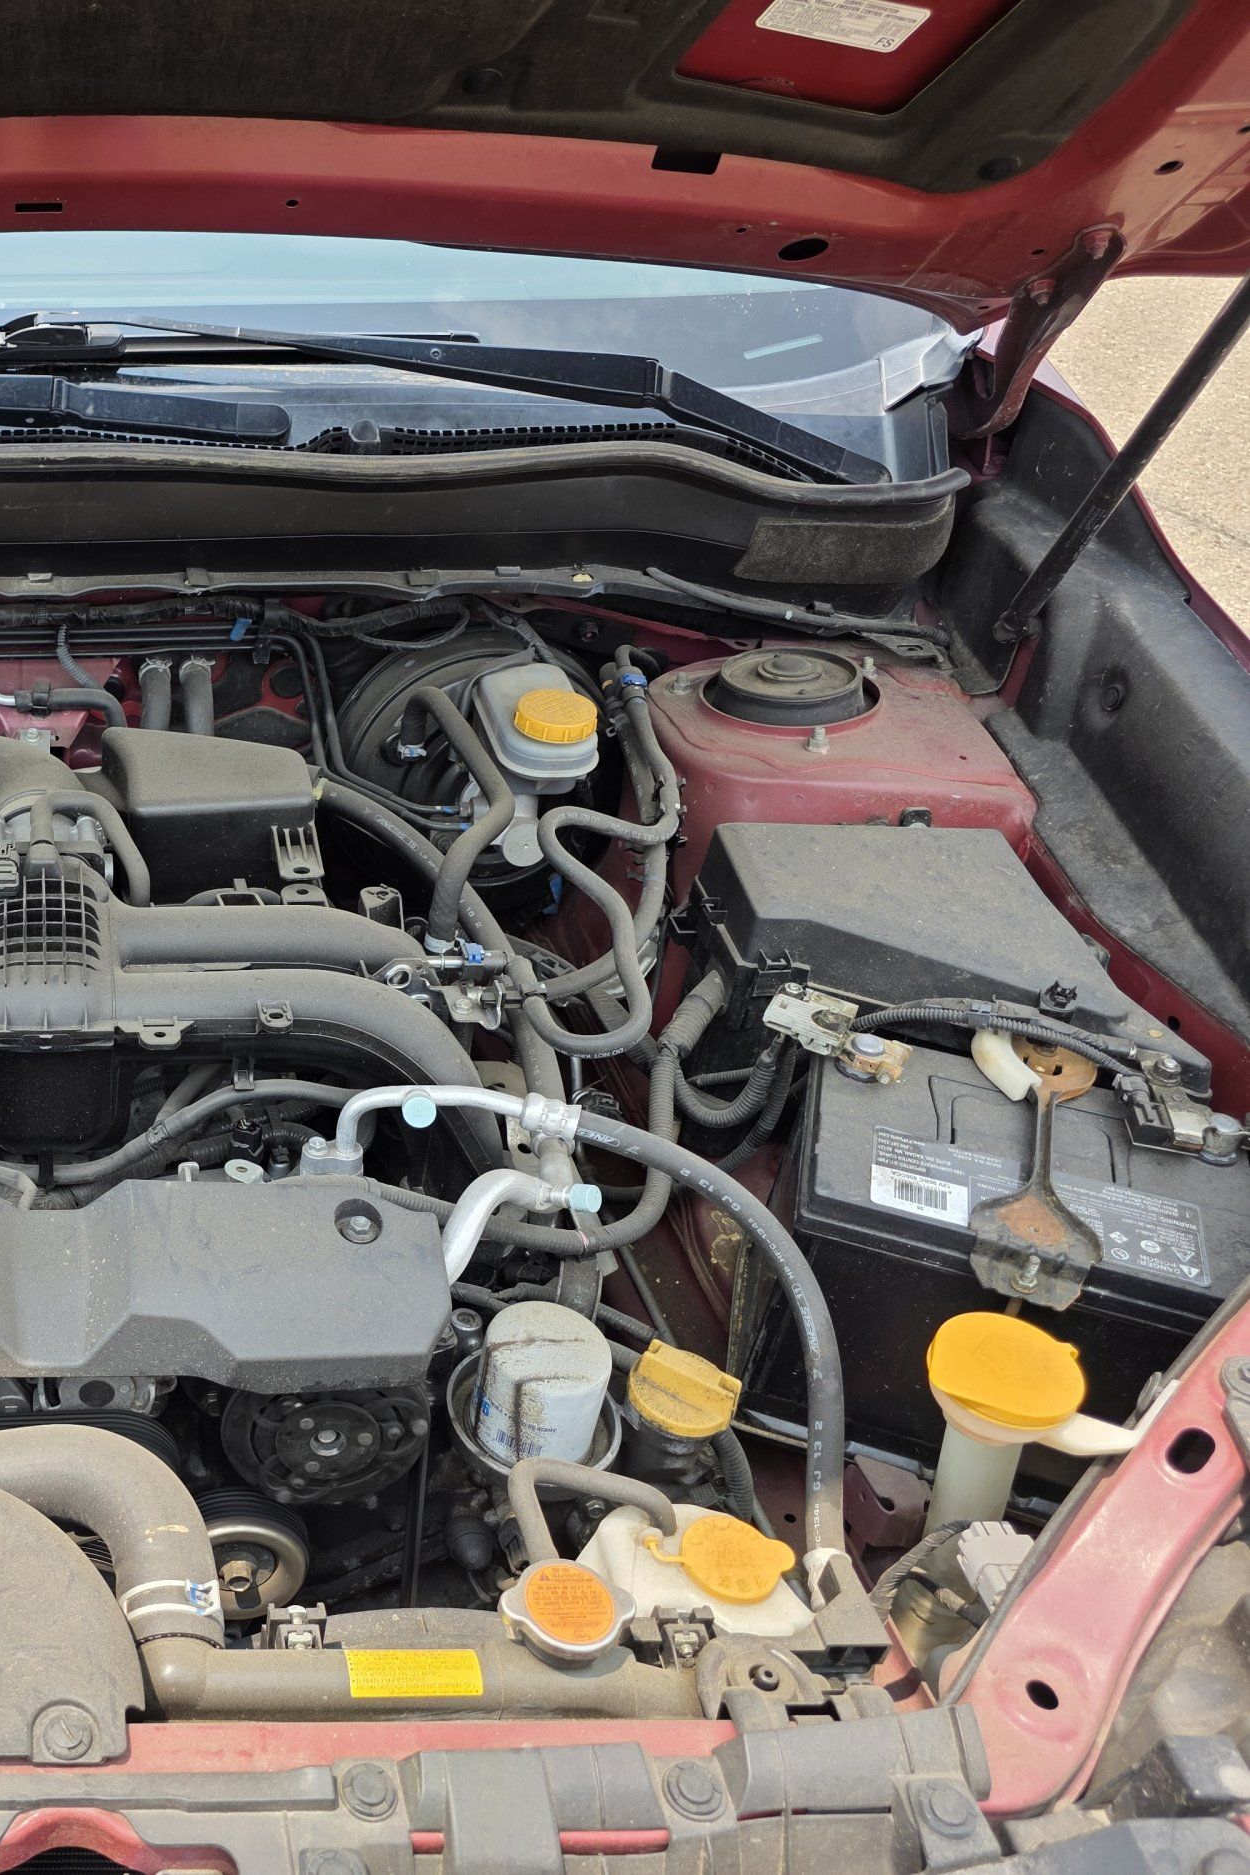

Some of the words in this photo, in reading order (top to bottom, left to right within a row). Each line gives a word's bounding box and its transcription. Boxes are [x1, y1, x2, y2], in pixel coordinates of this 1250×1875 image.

[874, 37, 895, 47] FS
[897, 1154, 918, 1164] CENTER
[919, 1159, 953, 1172] CORPORATE
[679, 1168, 691, 1177] 2
[898, 1161, 926, 1172] IMPORTED
[698, 1178, 714, 1192] 13
[976, 1182, 1009, 1194] RUCTIONS
[1138, 1253, 1176, 1267] POISON
[784, 1266, 794, 1280] HP
[794, 1287, 803, 1300] 11
[814, 1420, 823, 1430] 2
[814, 1441, 822, 1458] 13
[814, 1503, 822, 1549] FC-134a
